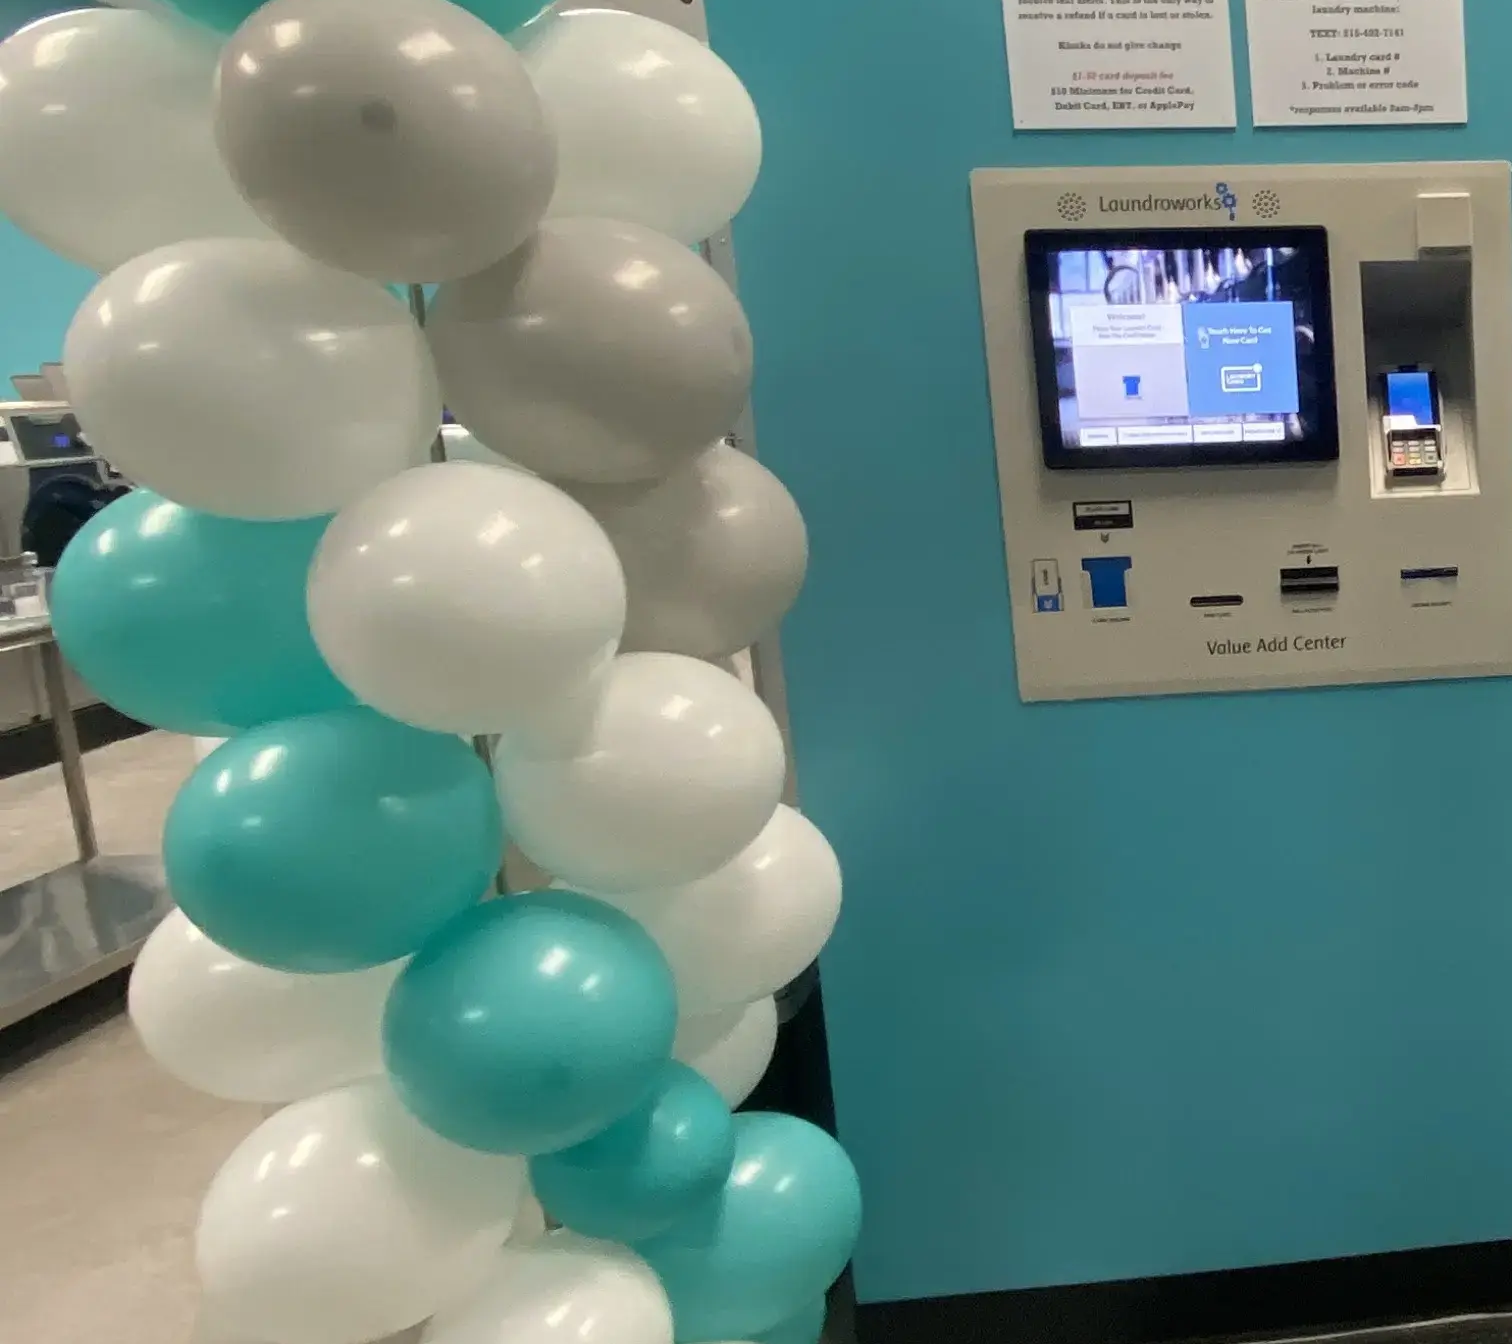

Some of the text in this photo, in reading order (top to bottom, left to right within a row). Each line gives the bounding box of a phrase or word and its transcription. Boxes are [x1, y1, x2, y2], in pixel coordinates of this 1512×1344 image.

[1100, 194, 1221, 212] Laundroworks
[1206, 634, 1347, 656] Value Add Center
